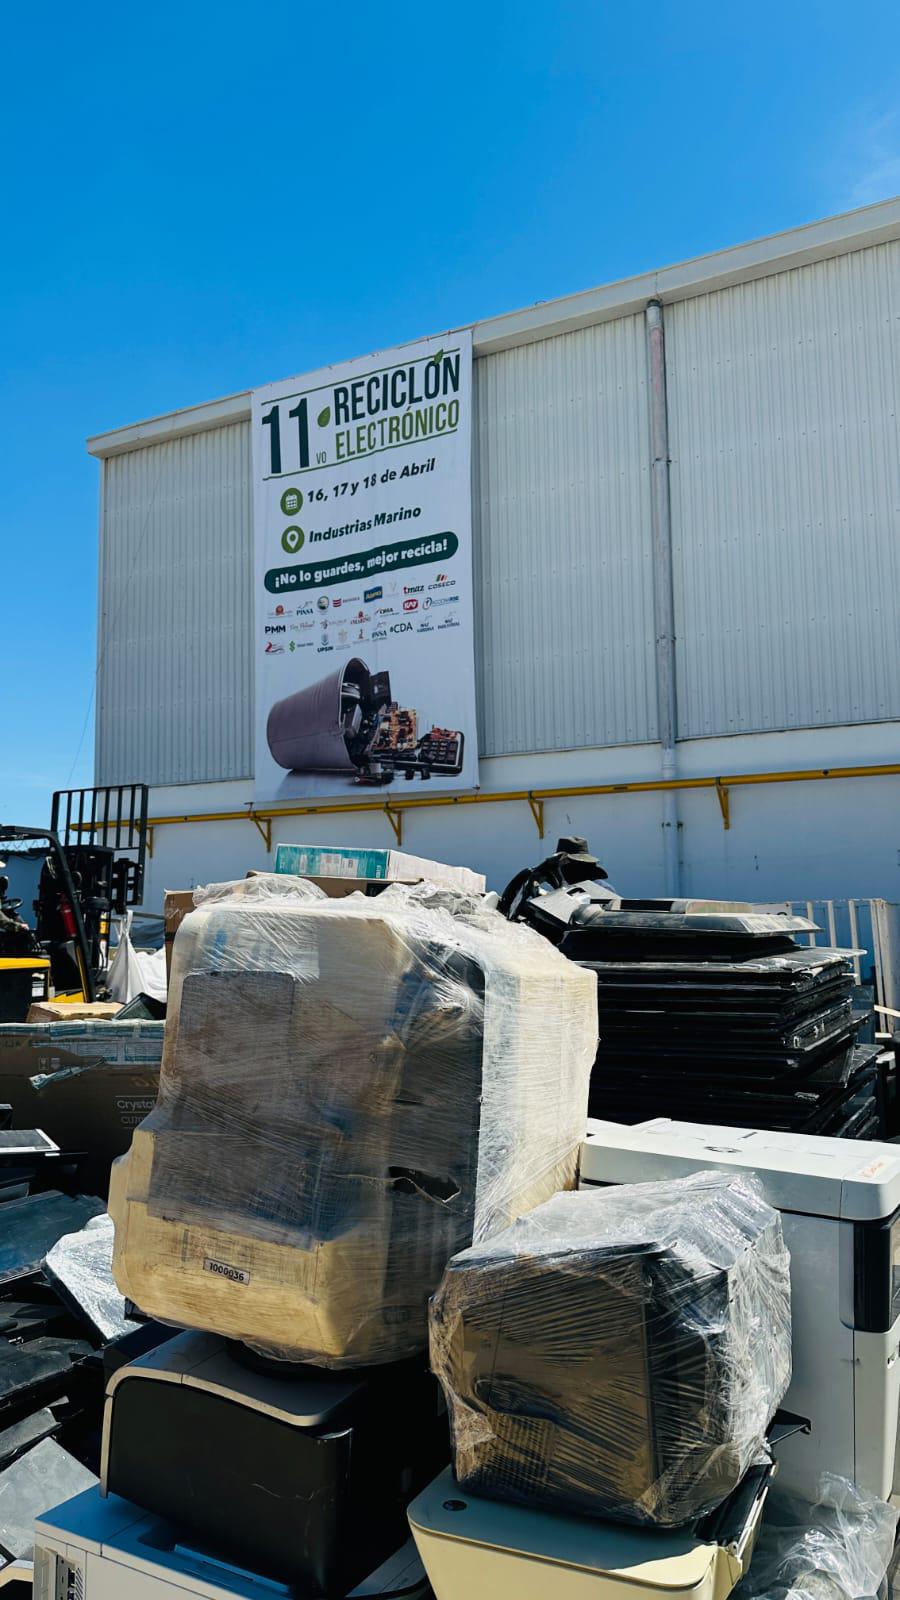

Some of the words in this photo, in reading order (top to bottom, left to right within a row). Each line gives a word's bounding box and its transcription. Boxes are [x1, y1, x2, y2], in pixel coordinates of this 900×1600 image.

[261, 397, 310, 474] 11
[335, 399, 460, 460] ELECTRÓNICO
[307, 488, 329, 503] 16,
[333, 482, 349, 497] 17
[350, 482, 360, 496] y
[363, 473, 377, 490] 18
[380, 469, 397, 484] de
[399, 457, 436, 480] Abril
[309, 518, 372, 543] Industrias
[374, 505, 421, 527] Marino
[299, 569, 312, 583] lo
[314, 560, 365, 582] guardes,
[366, 549, 399, 570] mejor
[401, 538, 448, 561] recicla!
[264, 625, 286, 634] PMM
[208, 1262, 245, 1282] 1000036
